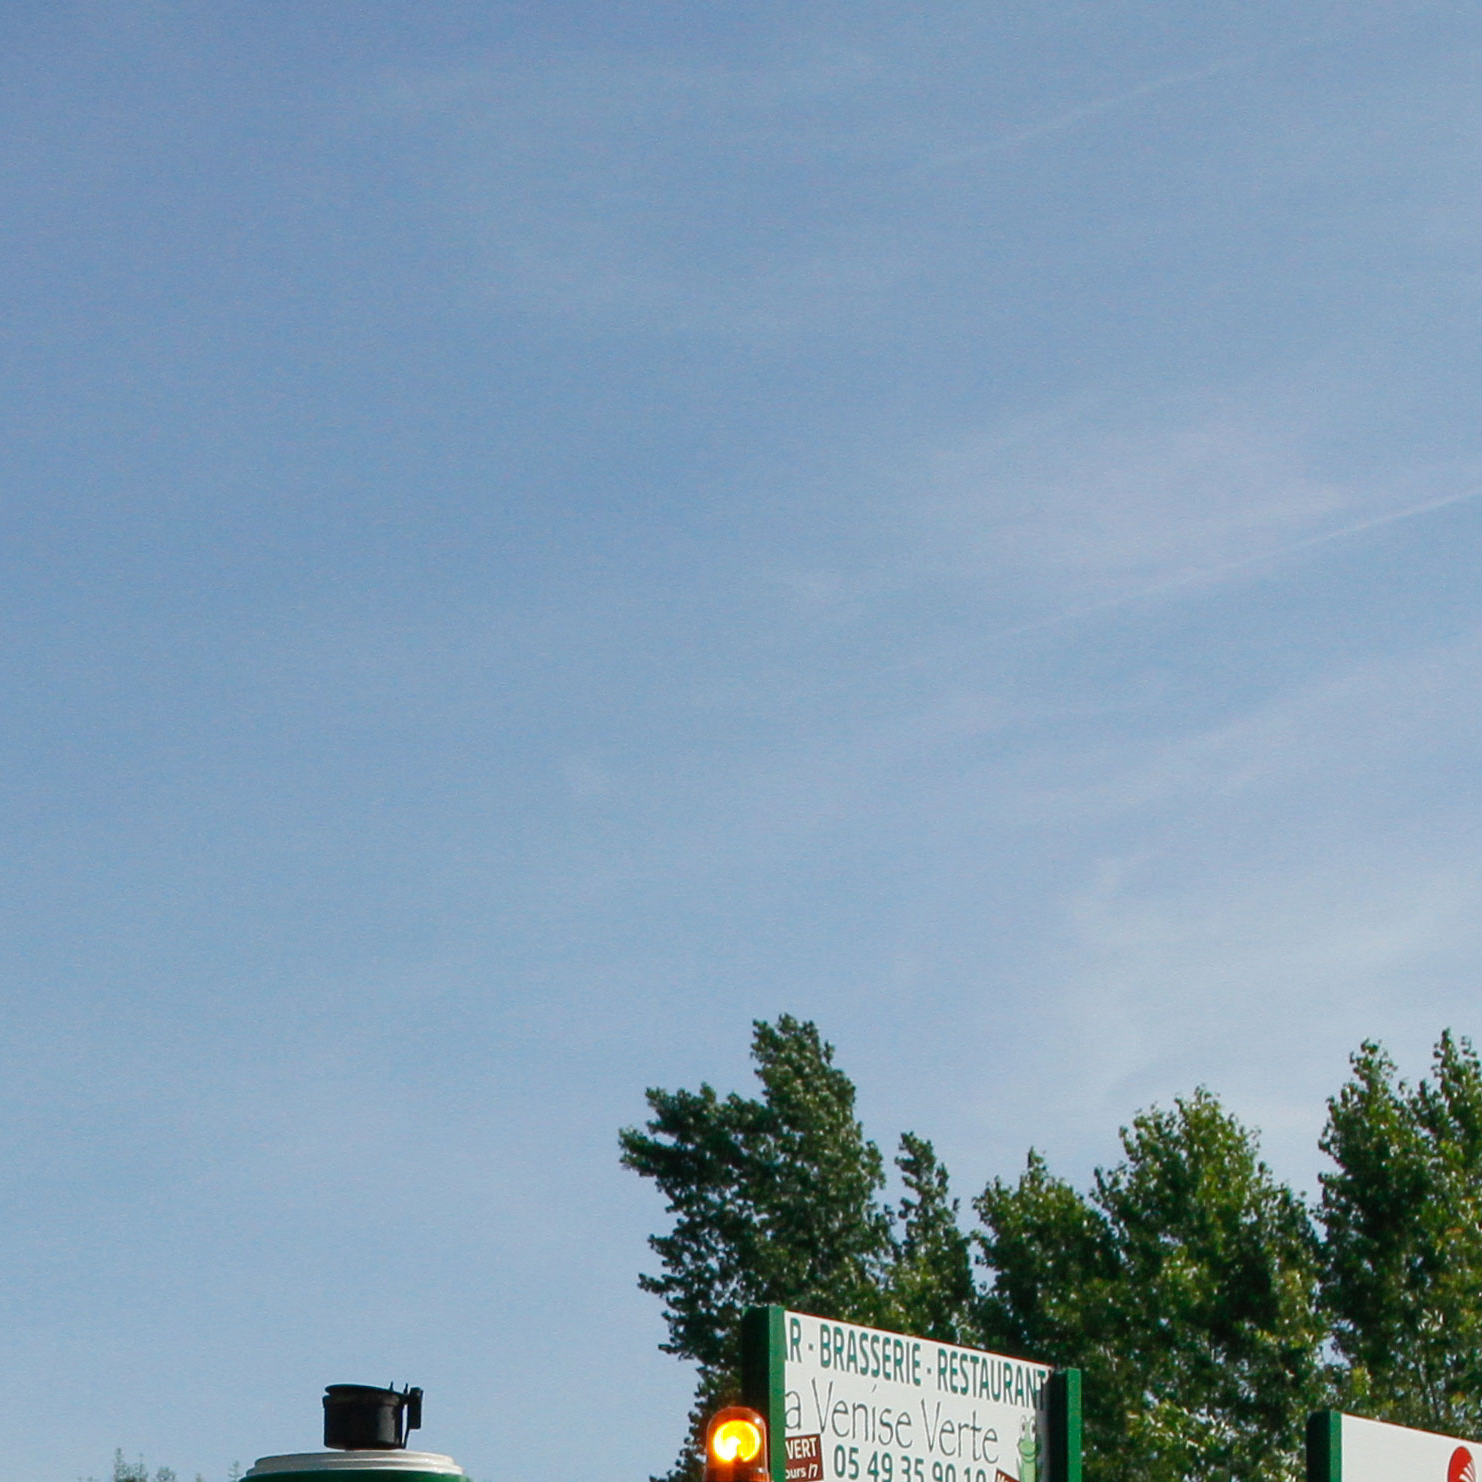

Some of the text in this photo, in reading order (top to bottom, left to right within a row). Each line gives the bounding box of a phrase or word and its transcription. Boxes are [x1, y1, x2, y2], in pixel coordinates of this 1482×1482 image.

[785, 1318, 802, 1363] R
[819, 1323, 921, 1387] BRASSERIE
[937, 1347, 1046, 1411] RESTAURANT
[811, 1377, 913, 1449] Venise
[920, 1398, 999, 1464] Verte
[834, 1444, 859, 1480] 05
